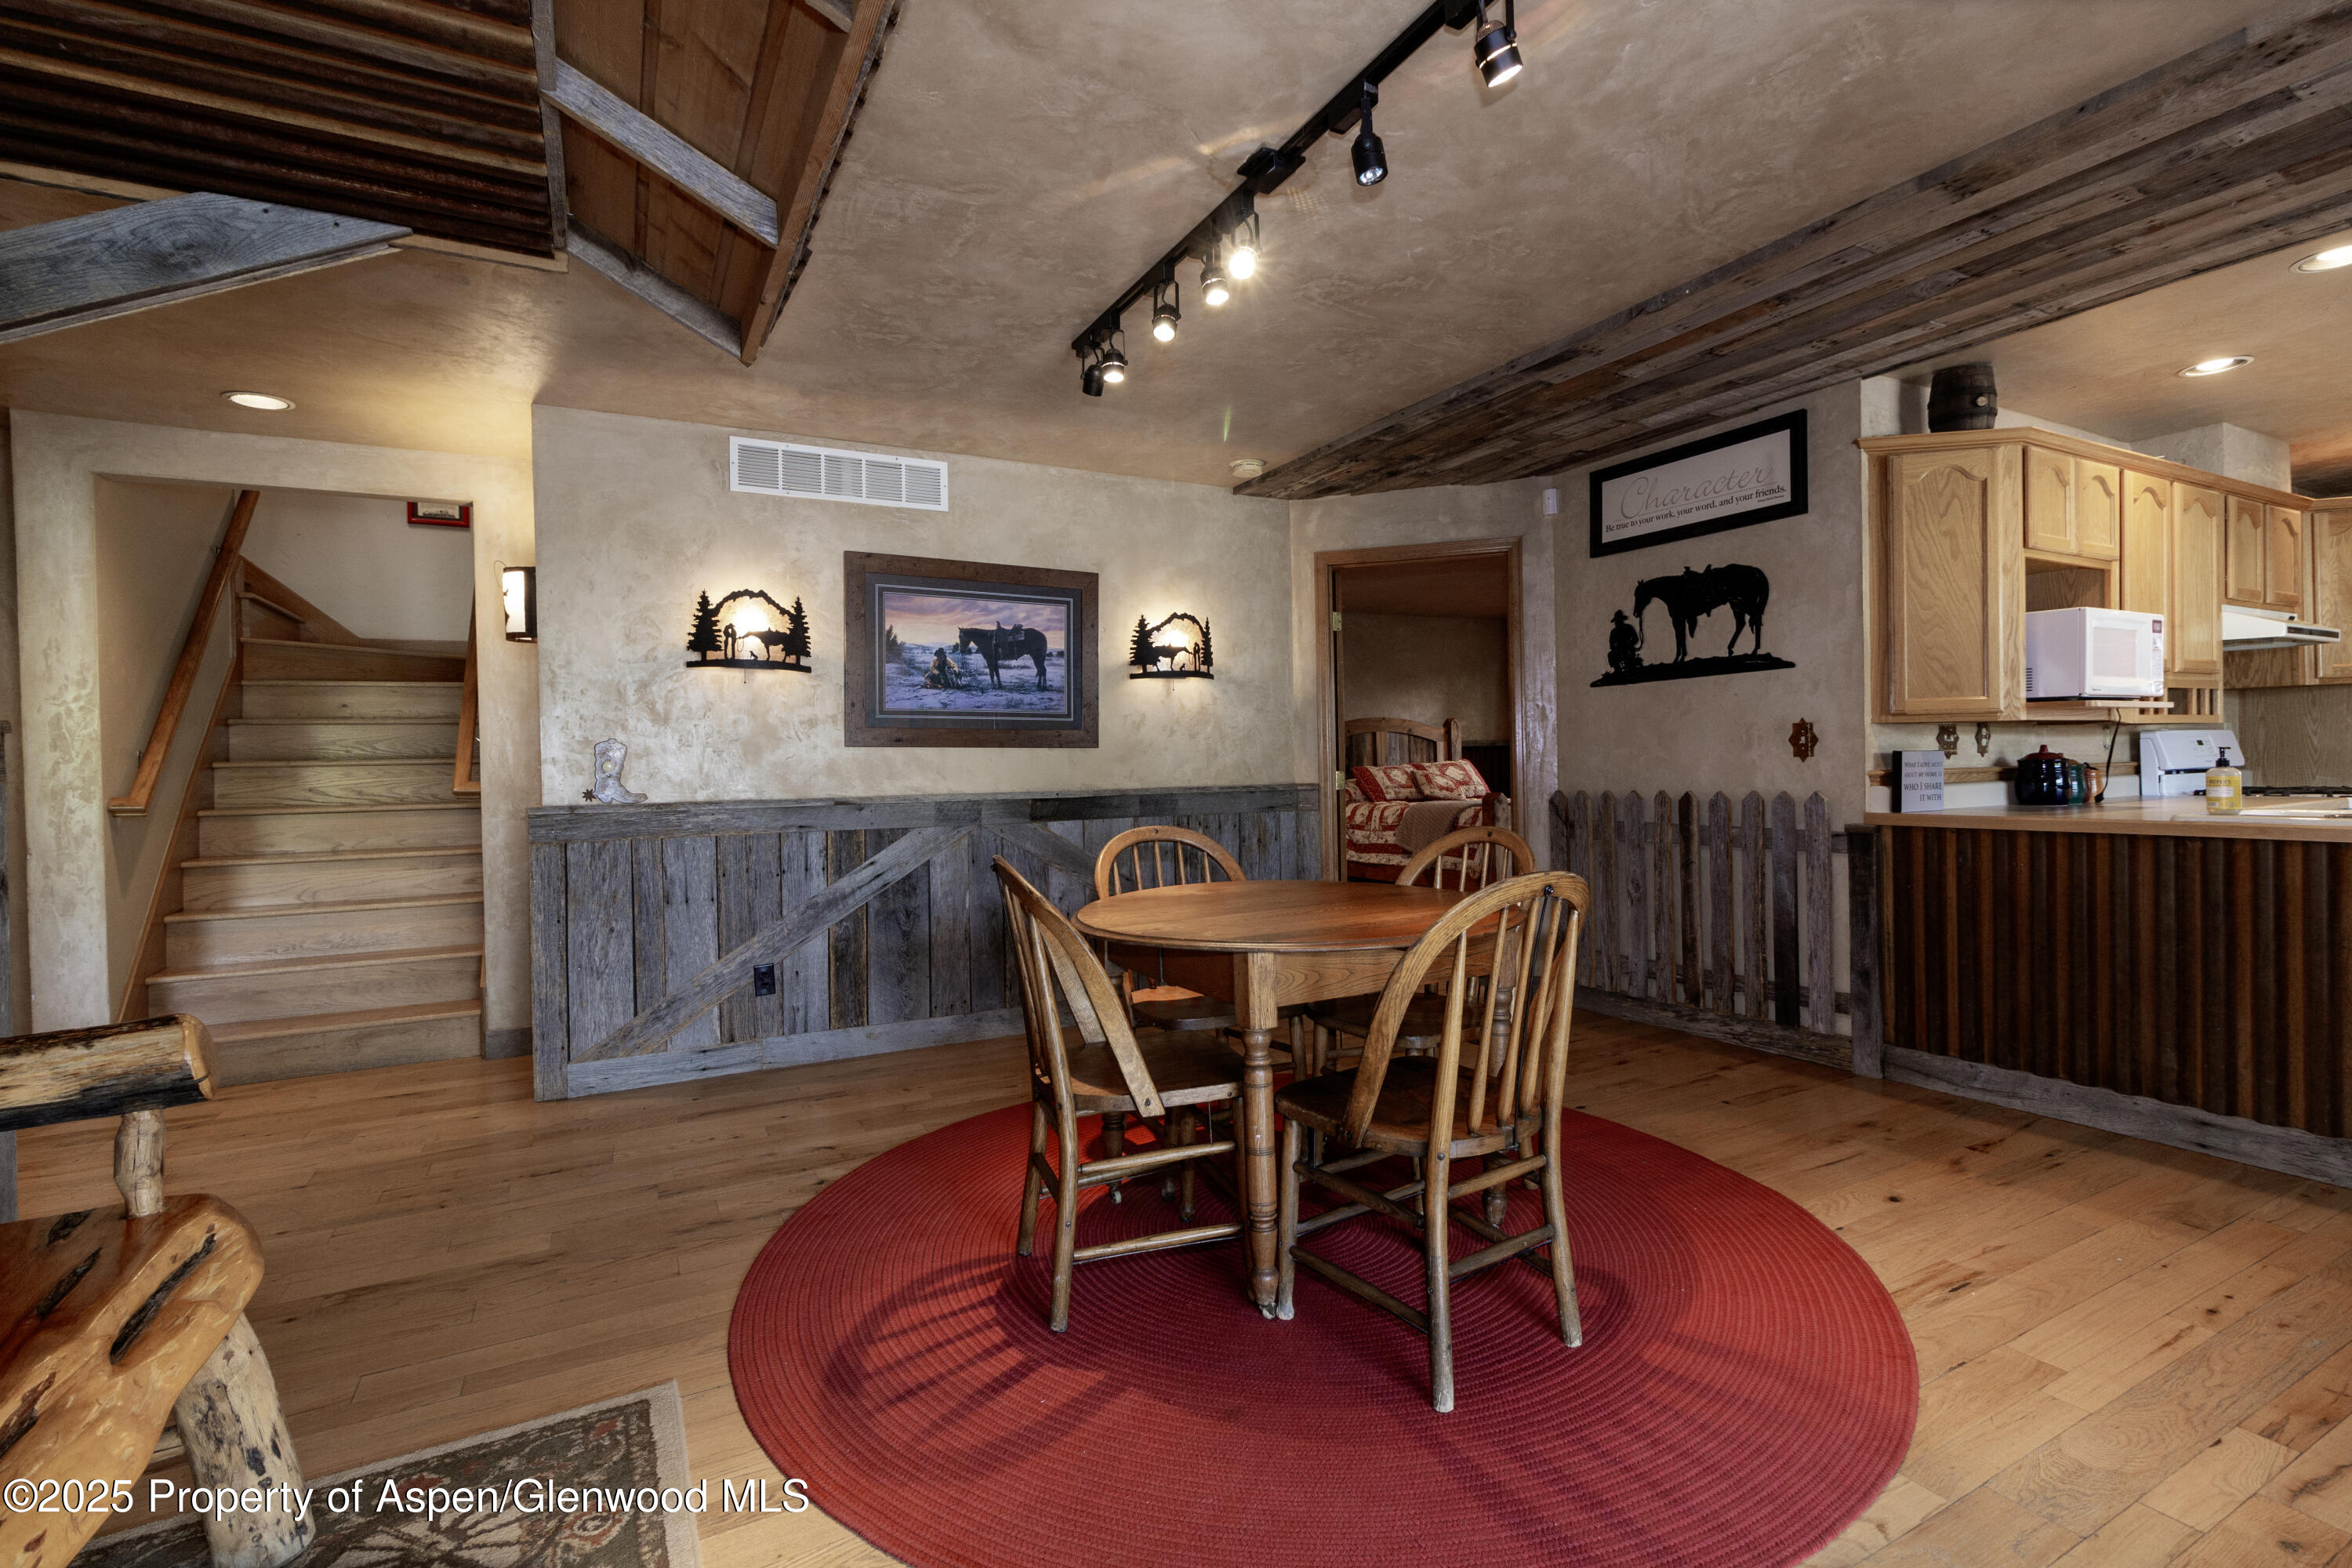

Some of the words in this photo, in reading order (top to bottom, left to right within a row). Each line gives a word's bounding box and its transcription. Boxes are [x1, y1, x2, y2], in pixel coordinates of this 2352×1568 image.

[1606, 524, 1616, 532] Be
[1616, 521, 1629, 530] true
[1639, 516, 1654, 527] your
[1677, 506, 1693, 518] your
[1719, 495, 1733, 506] and
[1735, 492, 1754, 505] your
[1755, 485, 1787, 499] friends.
[1621, 467, 1773, 519] Character
[1904, 782, 1919, 791] WHO
[1924, 782, 1943, 790] SHARE
